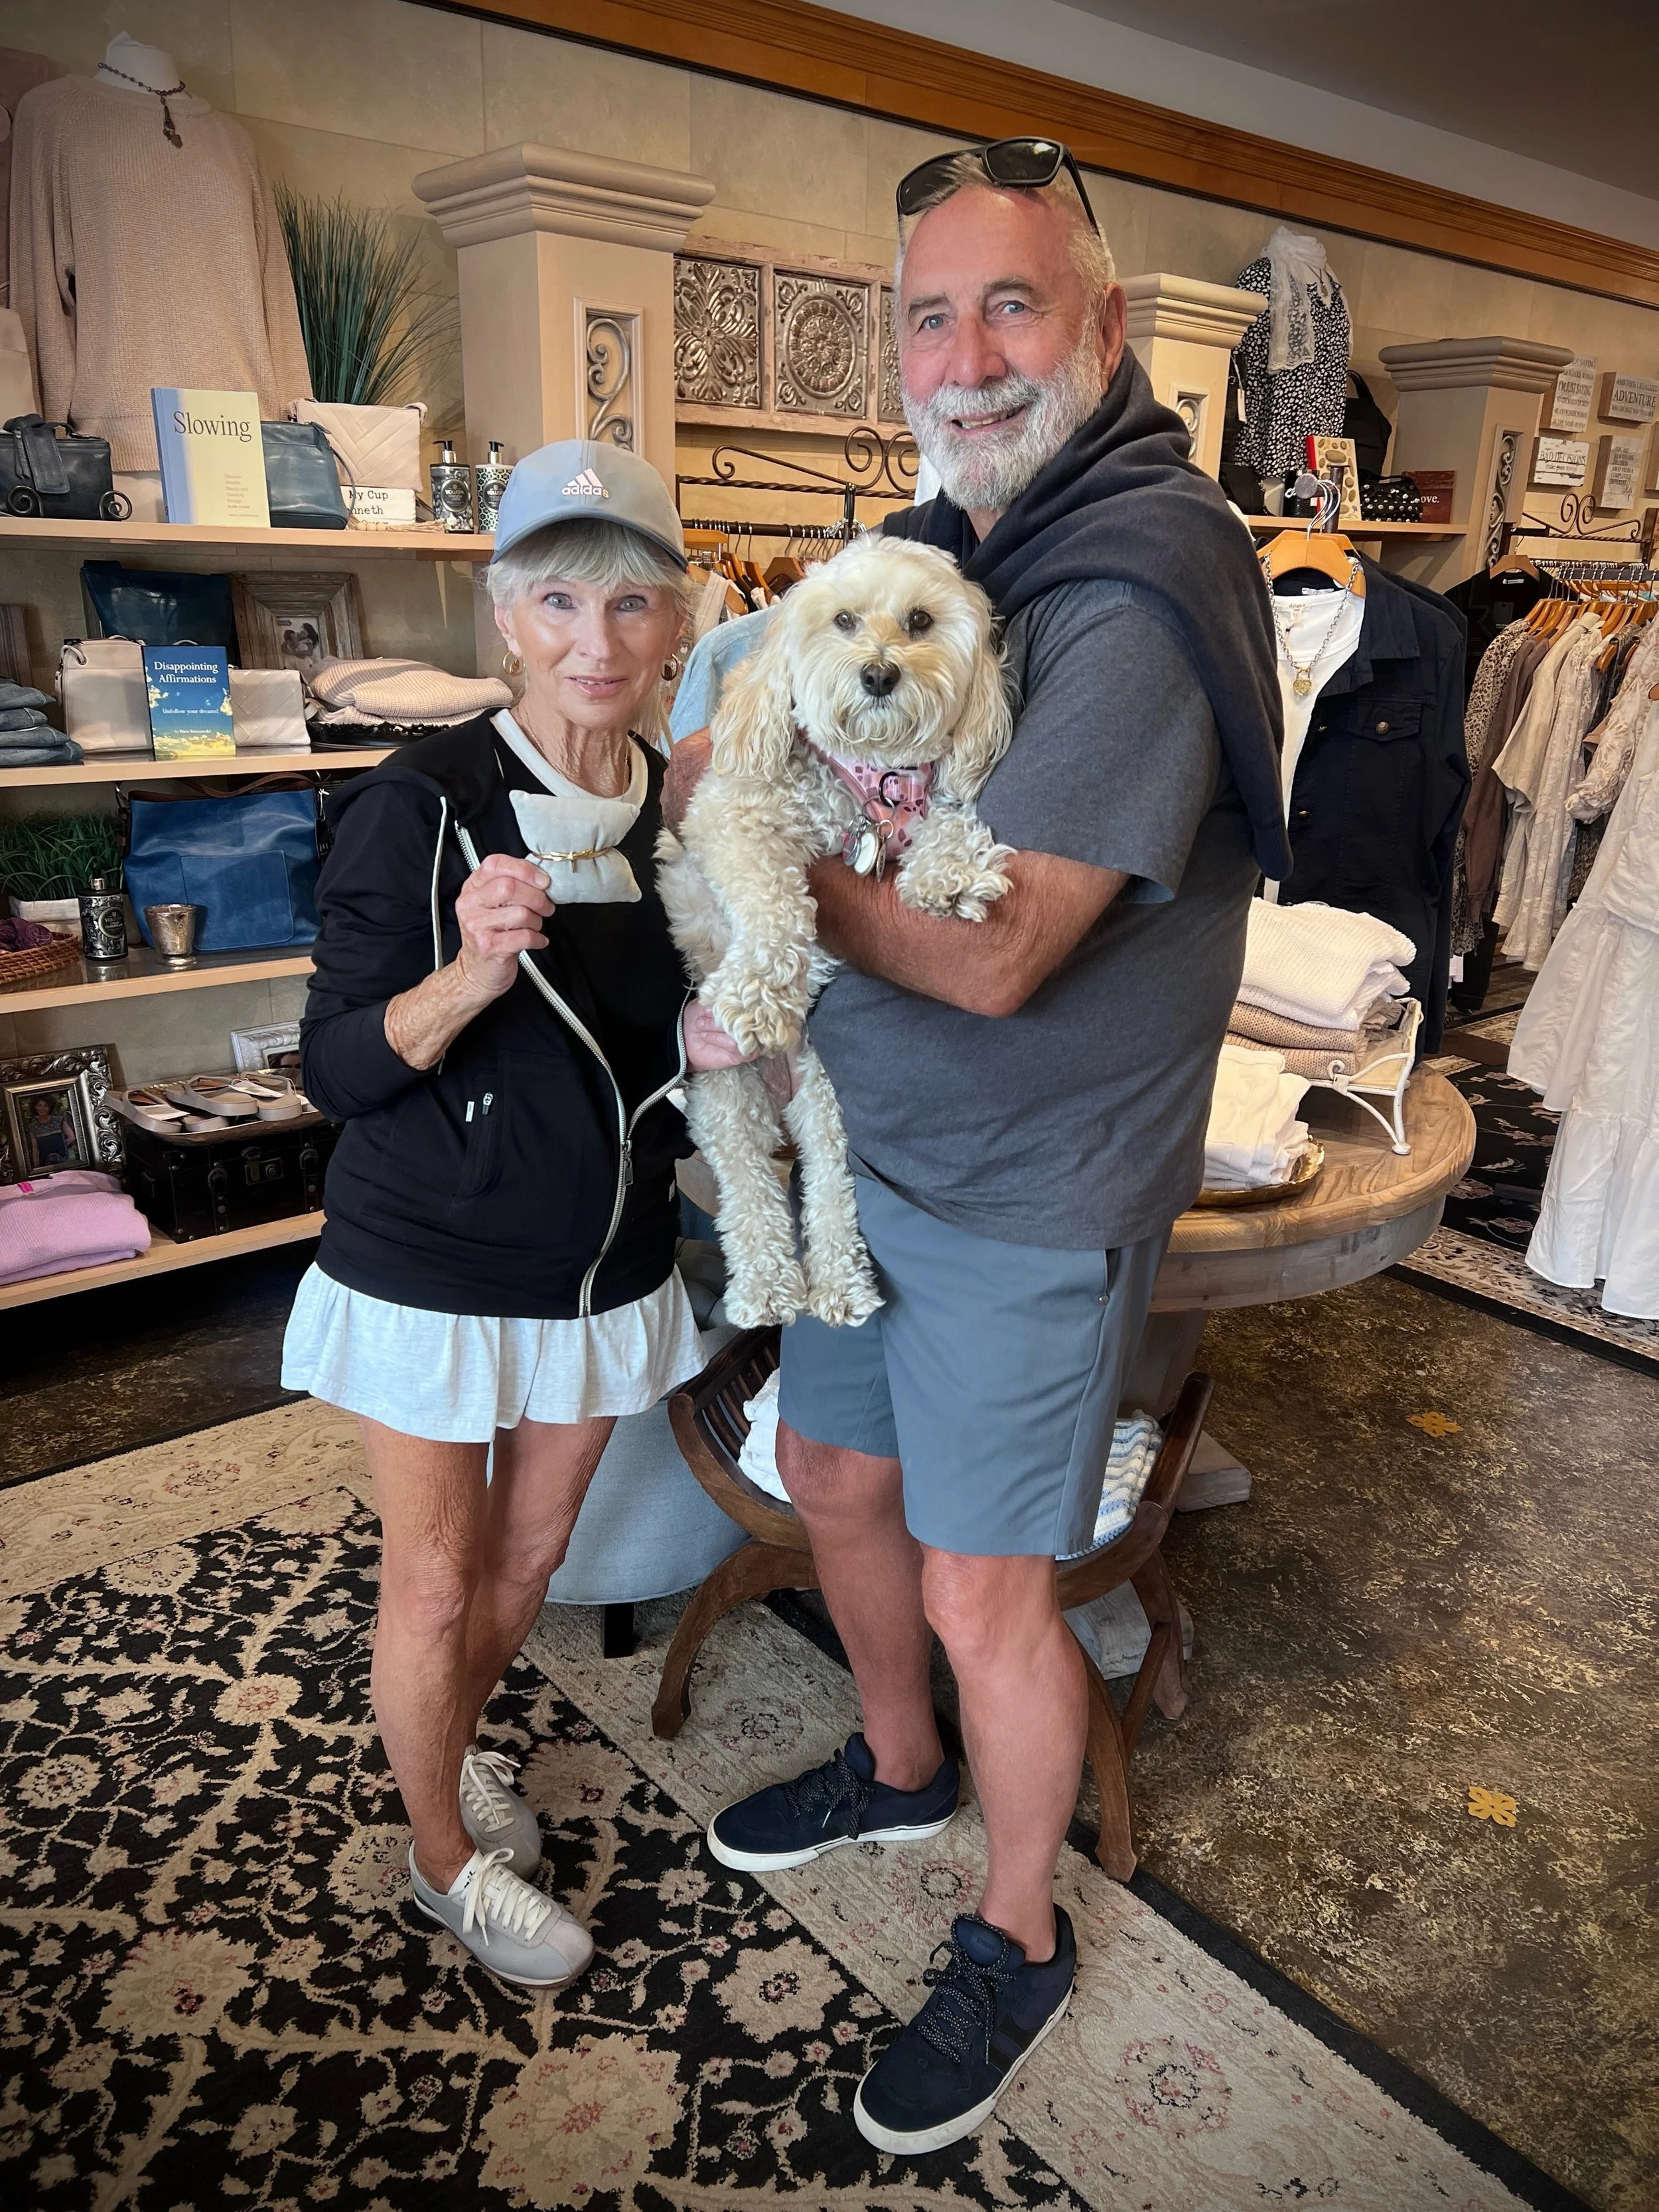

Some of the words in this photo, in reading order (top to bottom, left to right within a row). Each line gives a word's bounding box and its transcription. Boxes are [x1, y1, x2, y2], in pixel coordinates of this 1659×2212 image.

[1613, 389, 1656, 407] ADVENTURE
[173, 411, 252, 443] Slowing
[1540, 451, 1553, 461] BAD
[1555, 452, 1586, 463] DECISIONS
[368, 490, 388, 501] Cup
[561, 484, 609, 499] adidas
[154, 662, 219, 674] Disappointing
[159, 674, 216, 683] Affirmations
